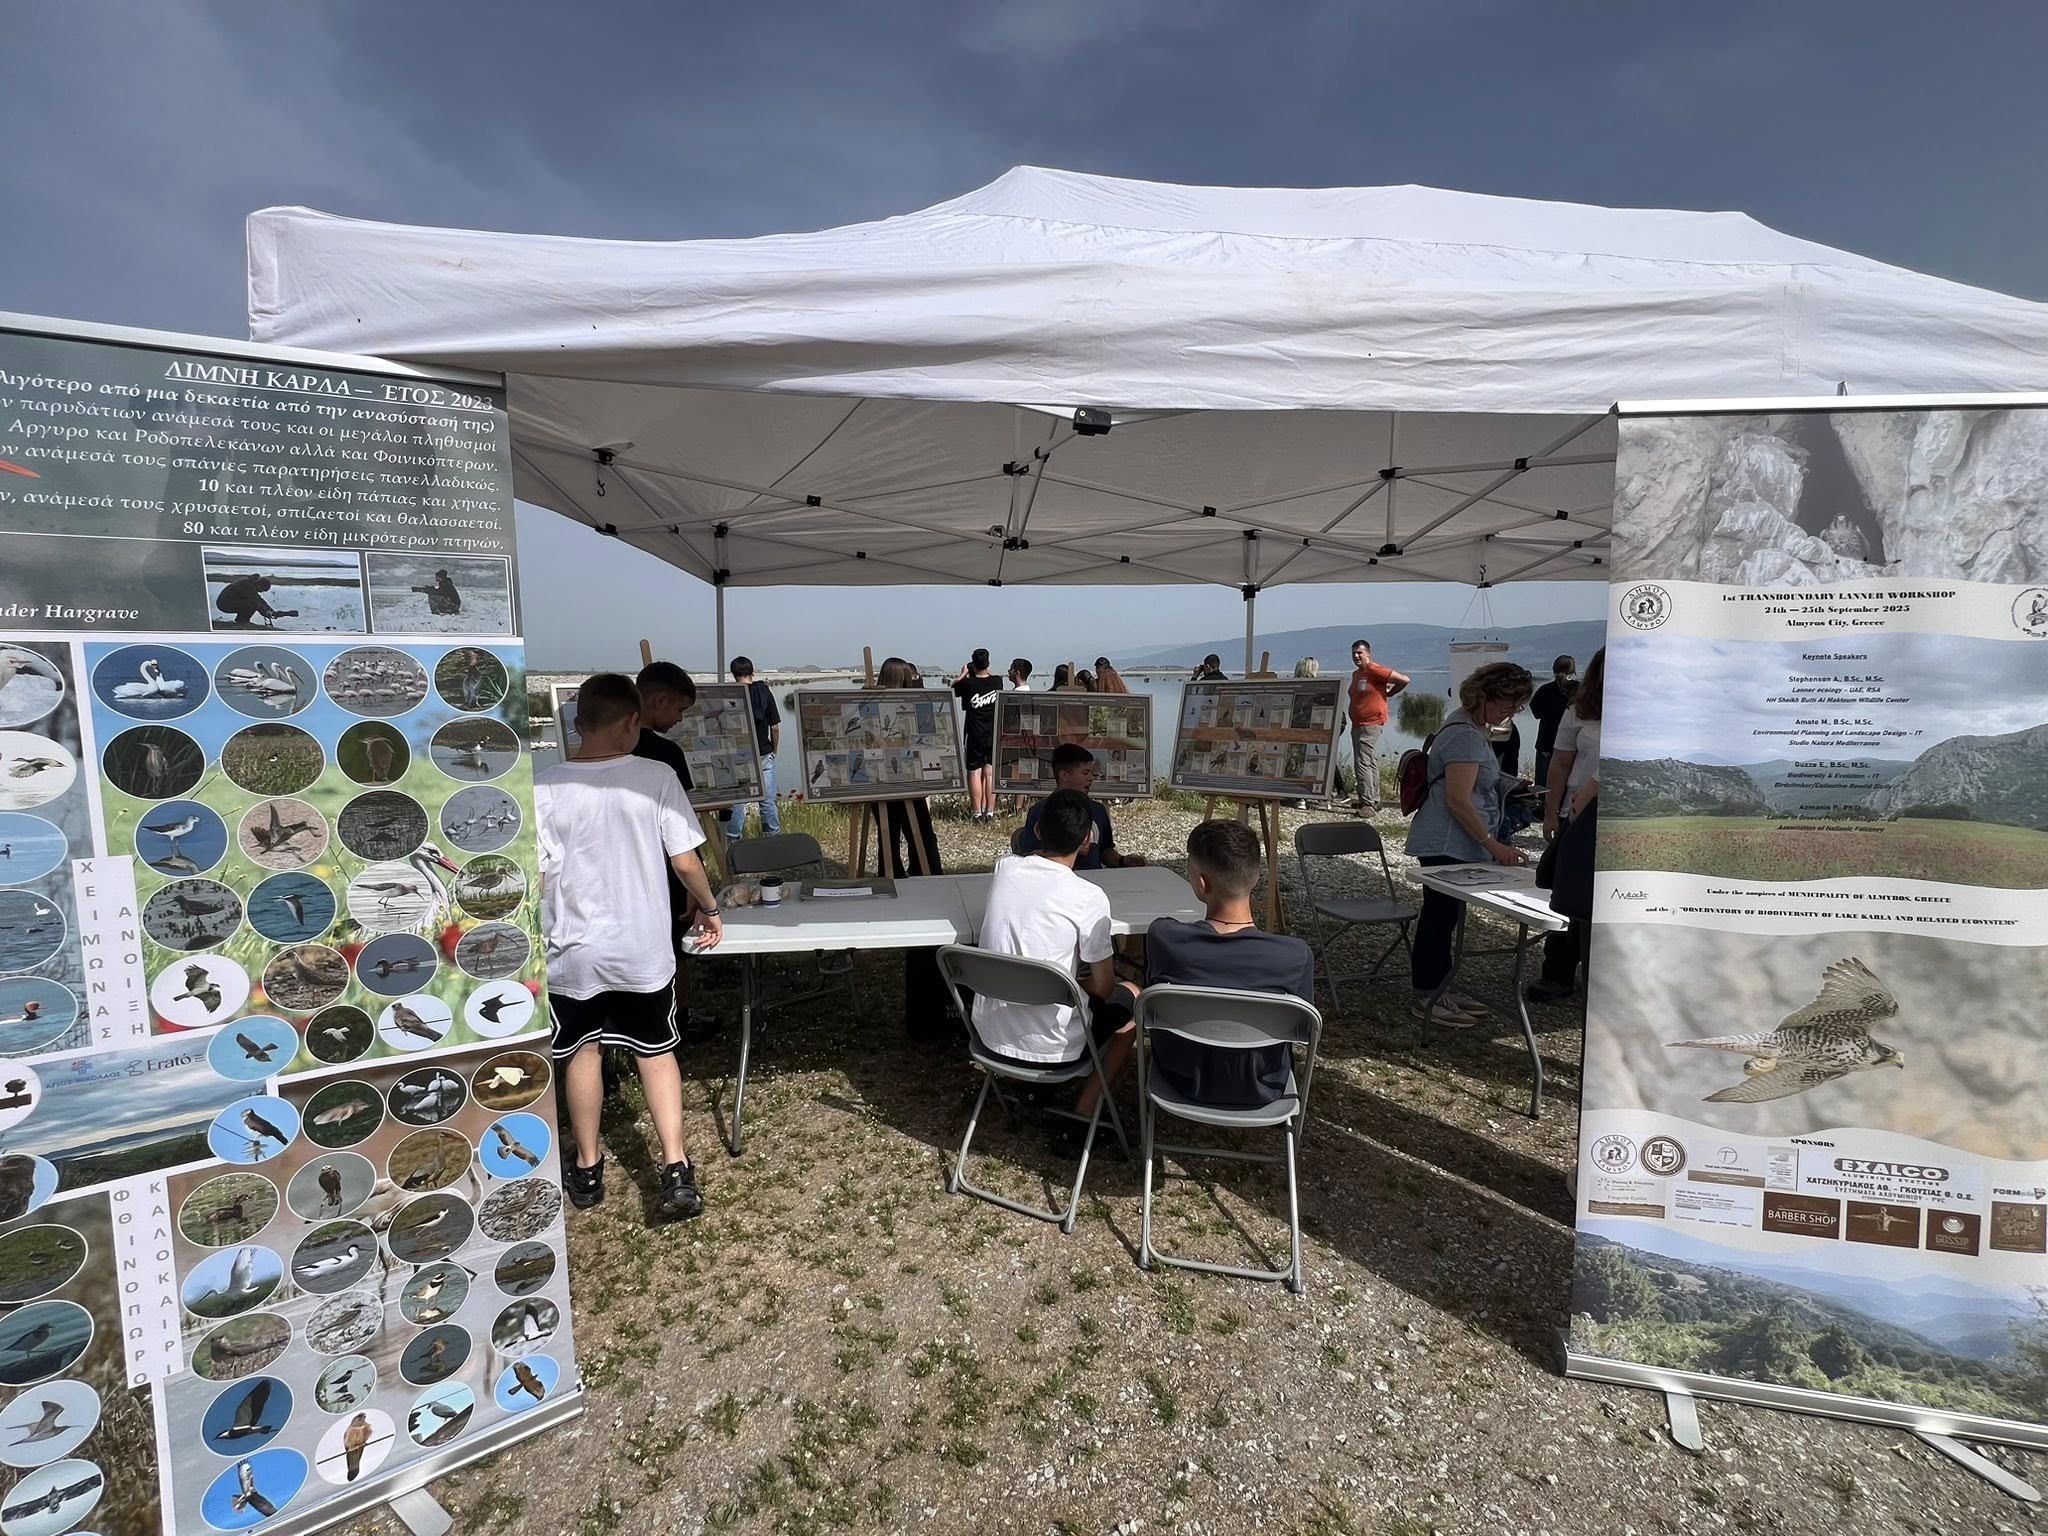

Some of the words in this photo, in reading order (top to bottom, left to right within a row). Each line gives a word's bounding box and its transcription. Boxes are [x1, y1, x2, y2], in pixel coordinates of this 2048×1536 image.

[164, 361, 259, 386] ΛΙΜΝΗ
[450, 392, 493, 410] 2023
[99, 384, 140, 398] από
[146, 388, 179, 403] μια
[185, 389, 270, 411] δεκαετία
[275, 400, 311, 414] από
[316, 405, 347, 420] την
[352, 409, 459, 432] ανασύστασή
[463, 419, 495, 434] της)
[20, 399, 146, 421] παρυδάτιων
[152, 410, 235, 429] ανάμεσά
[240, 419, 281, 434] τους
[287, 423, 315, 435] και
[319, 425, 335, 437] οι
[340, 426, 408, 444] μεγάλοι
[412, 434, 497, 454] πληθυσμοί
[8, 419, 89, 441] Αργυρο
[95, 430, 129, 441] και
[135, 429, 285, 453] Ροδοπελεκάνων
[290, 444, 336, 458] αλλά
[342, 449, 369, 461] και
[374, 450, 498, 476] Φοινικόπτερων.
[25, 447, 116, 464] ανάμεσά
[122, 453, 167, 468] τους
[172, 456, 247, 474] σπάνιες
[253, 463, 375, 484] παρατηρήσεις
[380, 471, 500, 492] πανελλαδικώς.
[199, 479, 219, 492] 10
[225, 483, 254, 495] και
[260, 484, 313, 499] πλέον
[318, 487, 351, 504] είδη
[357, 490, 417, 507] πάπιας
[422, 495, 447, 507] και
[451, 496, 501, 512] χήνας.
[23, 491, 114, 509] ανάμεσά
[121, 498, 165, 513] τους
[171, 501, 272, 519] χρυσαετοί,
[277, 507, 361, 522] σπιζαετοί
[366, 513, 392, 523] και
[397, 513, 502, 530] θαλασσαετοί.
[183, 521, 204, 535] 80
[209, 525, 239, 537] και
[245, 525, 299, 539] πλέον
[304, 528, 338, 544] είδη
[343, 529, 438, 548] μικρότερων
[443, 536, 504, 550] πτηνών.
[1739, 592, 1834, 601] TRANSBOUNDARY
[1839, 592, 1884, 600] LANNER
[1887, 591, 1956, 599] WORKSHOP
[45, 604, 140, 624] Hargrave
[1828, 605, 1879, 615] September
[1882, 605, 1910, 613] 2025
[1785, 619, 1825, 628] Almyros
[1802, 653, 1832, 661] Keynote
[1833, 653, 1867, 661] Speakers
[1788, 891, 1850, 899] MUNICIPALITY
[1757, 909, 1819, 917] BIODIVERSITY
[1861, 913, 1892, 921] KARLA
[1916, 916, 1959, 924] RELATED
[1790, 1138, 1835, 1148] SPONSORS
[1842, 1160, 1942, 1179] EXALCO
[1768, 1209, 1806, 1223] BARBER
[1809, 1213, 1837, 1226] SHOP
